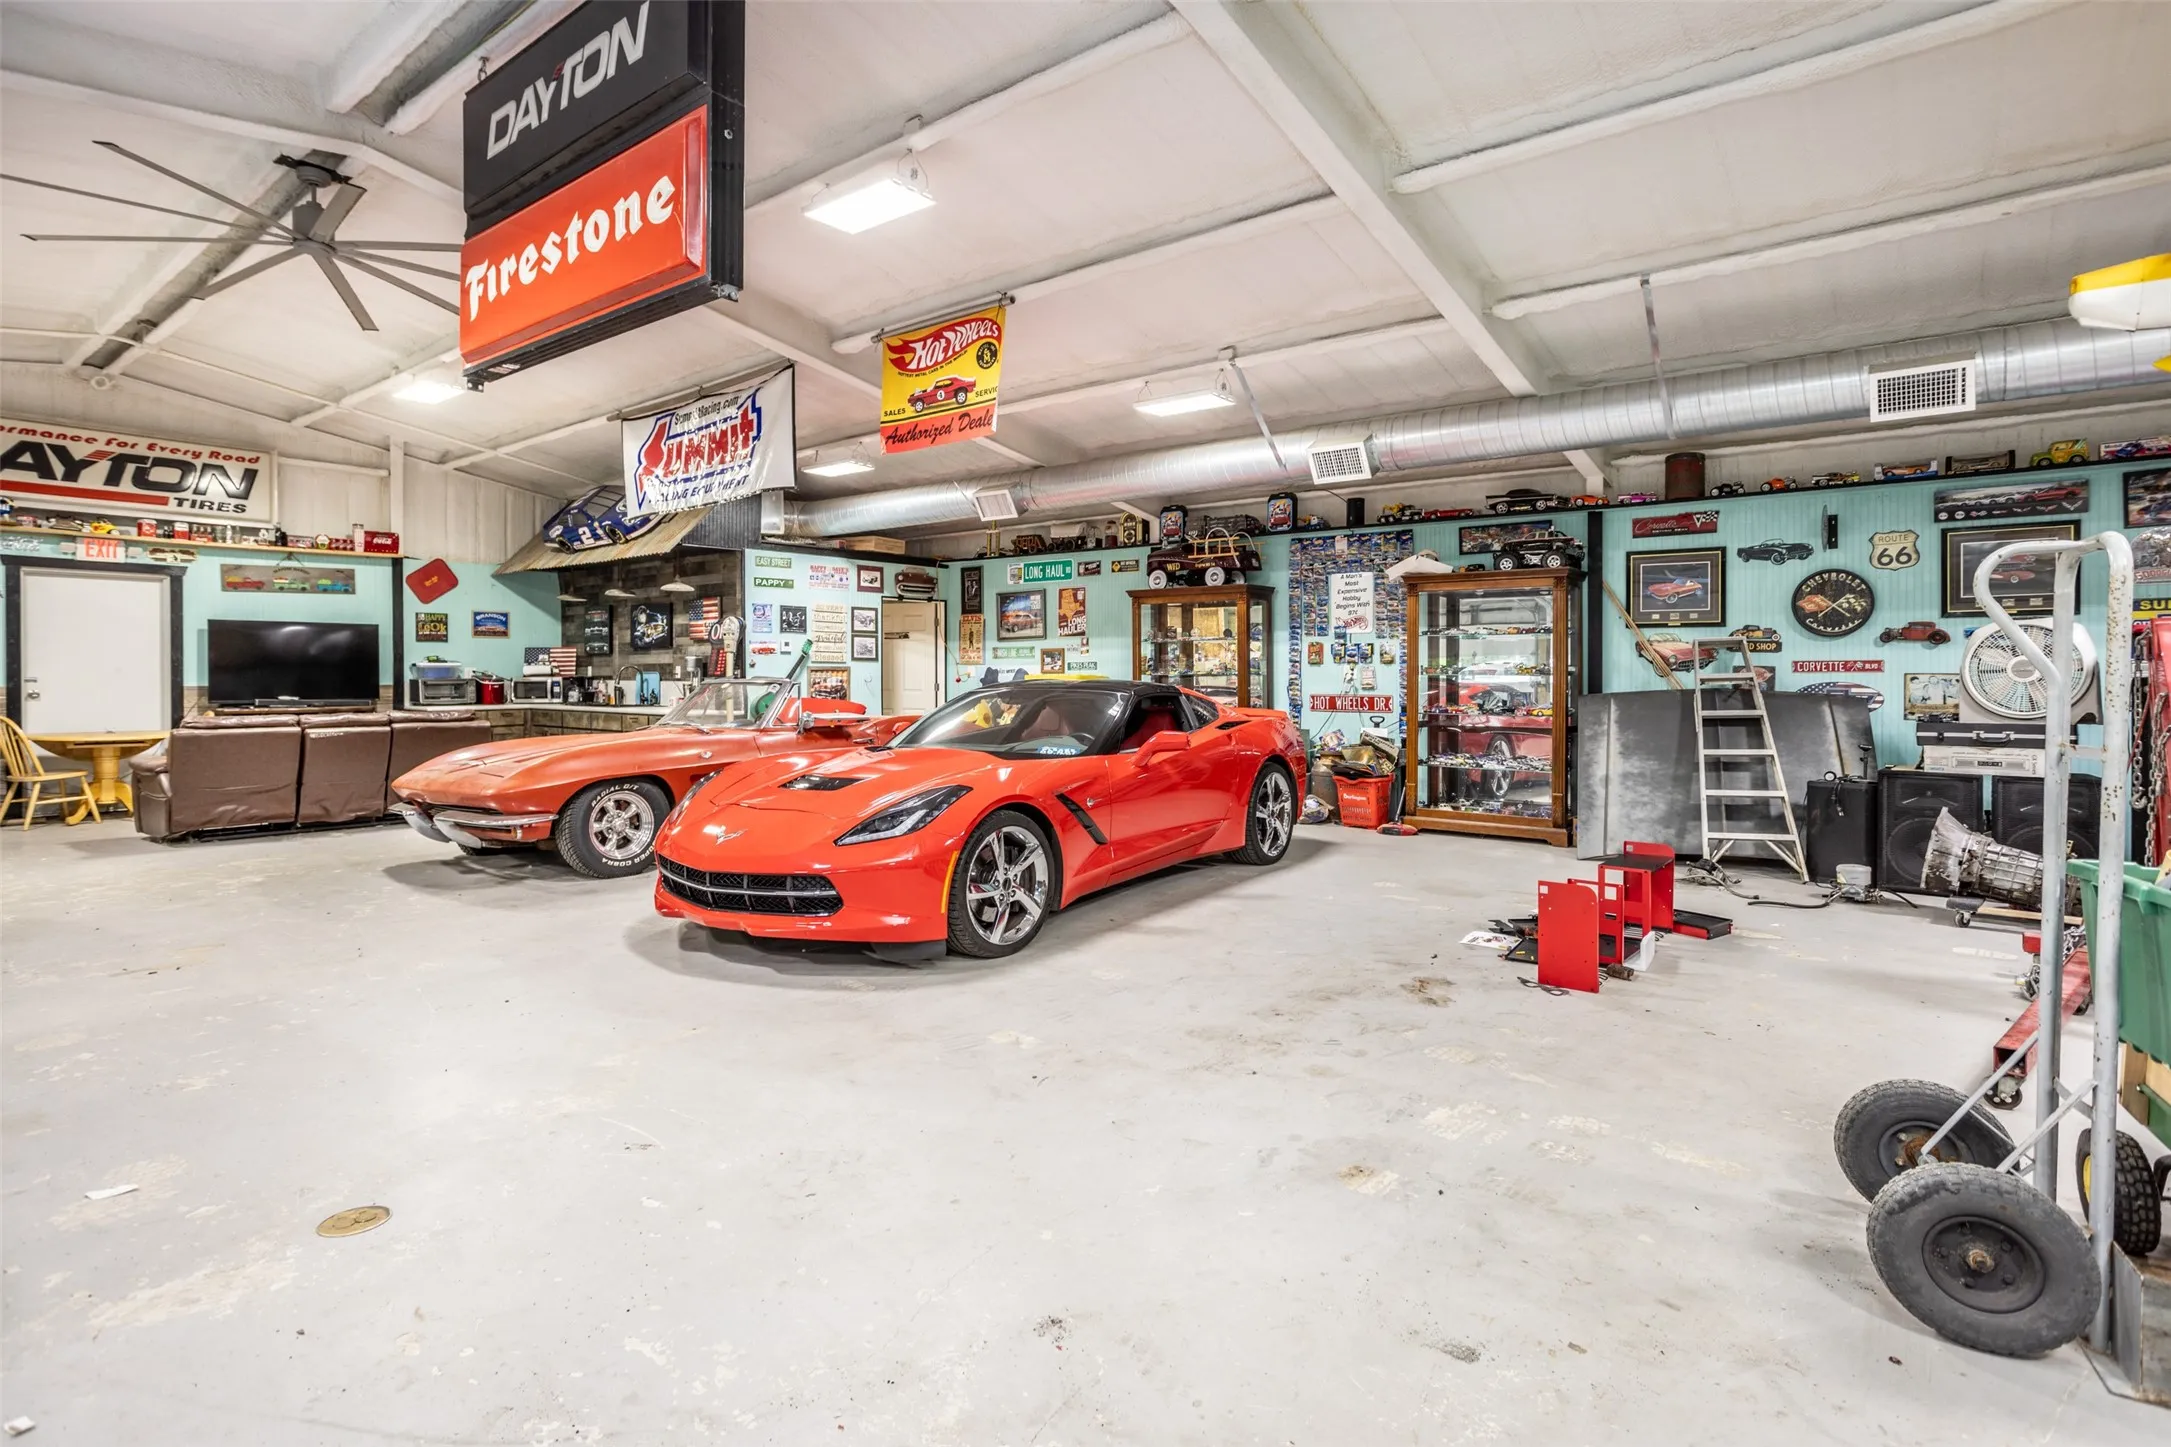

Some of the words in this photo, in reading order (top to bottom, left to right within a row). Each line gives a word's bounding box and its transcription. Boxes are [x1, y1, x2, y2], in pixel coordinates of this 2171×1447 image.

[486, 0, 650, 161] DAYTON
[464, 175, 676, 322] Firestone
[927, 367, 939, 375] CARS
[944, 359, 953, 368] THE
[975, 385, 998, 398] SERVIC
[883, 407, 906, 417] SALES
[885, 416, 954, 445] Authorized
[957, 408, 994, 433] Deale
[0, 424, 98, 445] ormance
[104, 437, 139, 449] For
[146, 442, 207, 461] Every
[208, 450, 261, 467] Road
[0, 439, 259, 501] AYTON
[172, 496, 248, 514] TIRES
[577, 526, 595, 545] 2
[1877, 534, 1910, 545] ROUTE
[83, 538, 120, 559] EXIT
[756, 557, 771, 566] EASY
[771, 558, 791, 568] STREET
[1876, 546, 1912, 567] 66
[1024, 565, 1043, 580] LONG
[1045, 563, 1065, 578] HAUL
[755, 578, 785, 587] PAPPY
[1801, 572, 1867, 593] CHEVROLET
[1336, 602, 1356, 610] Begins
[1356, 600, 1371, 608] With
[475, 613, 506, 621] BRANSON
[1067, 615, 1086, 627] LONG
[1057, 623, 1087, 636] HAULER
[1805, 618, 1863, 633] Corvette
[1756, 642, 1777, 651] SHOP
[1797, 661, 1845, 672] CORVETTE
[1313, 696, 1330, 710] HOT
[1335, 696, 1369, 711] WHEELS
[1374, 697, 1389, 711] DR.
[591, 784, 621, 808] RADIAL
[633, 842, 656, 864] OPER
[601, 857, 632, 867] COBRA
